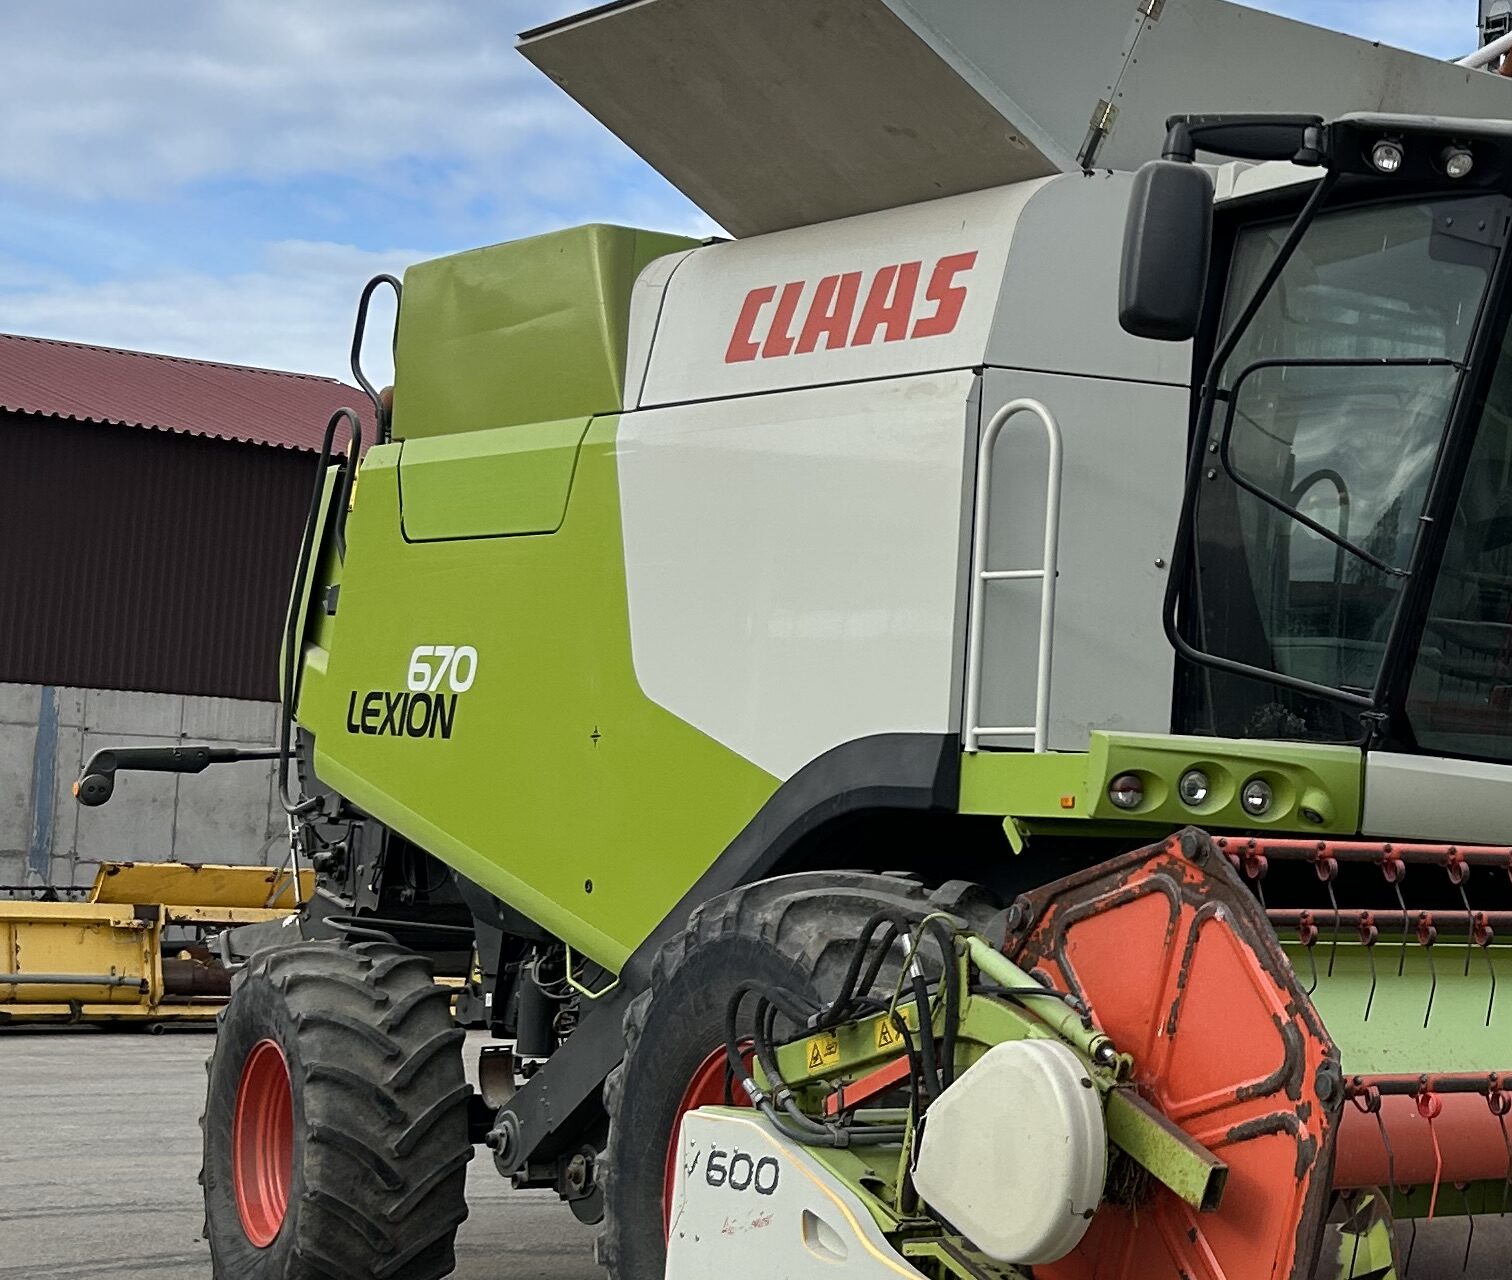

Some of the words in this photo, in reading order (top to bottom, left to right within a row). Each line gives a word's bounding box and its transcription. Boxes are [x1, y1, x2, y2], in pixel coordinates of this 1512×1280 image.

[725, 251, 978, 363] CLAAS
[407, 646, 478, 692] 670
[347, 690, 458, 739] LEXION
